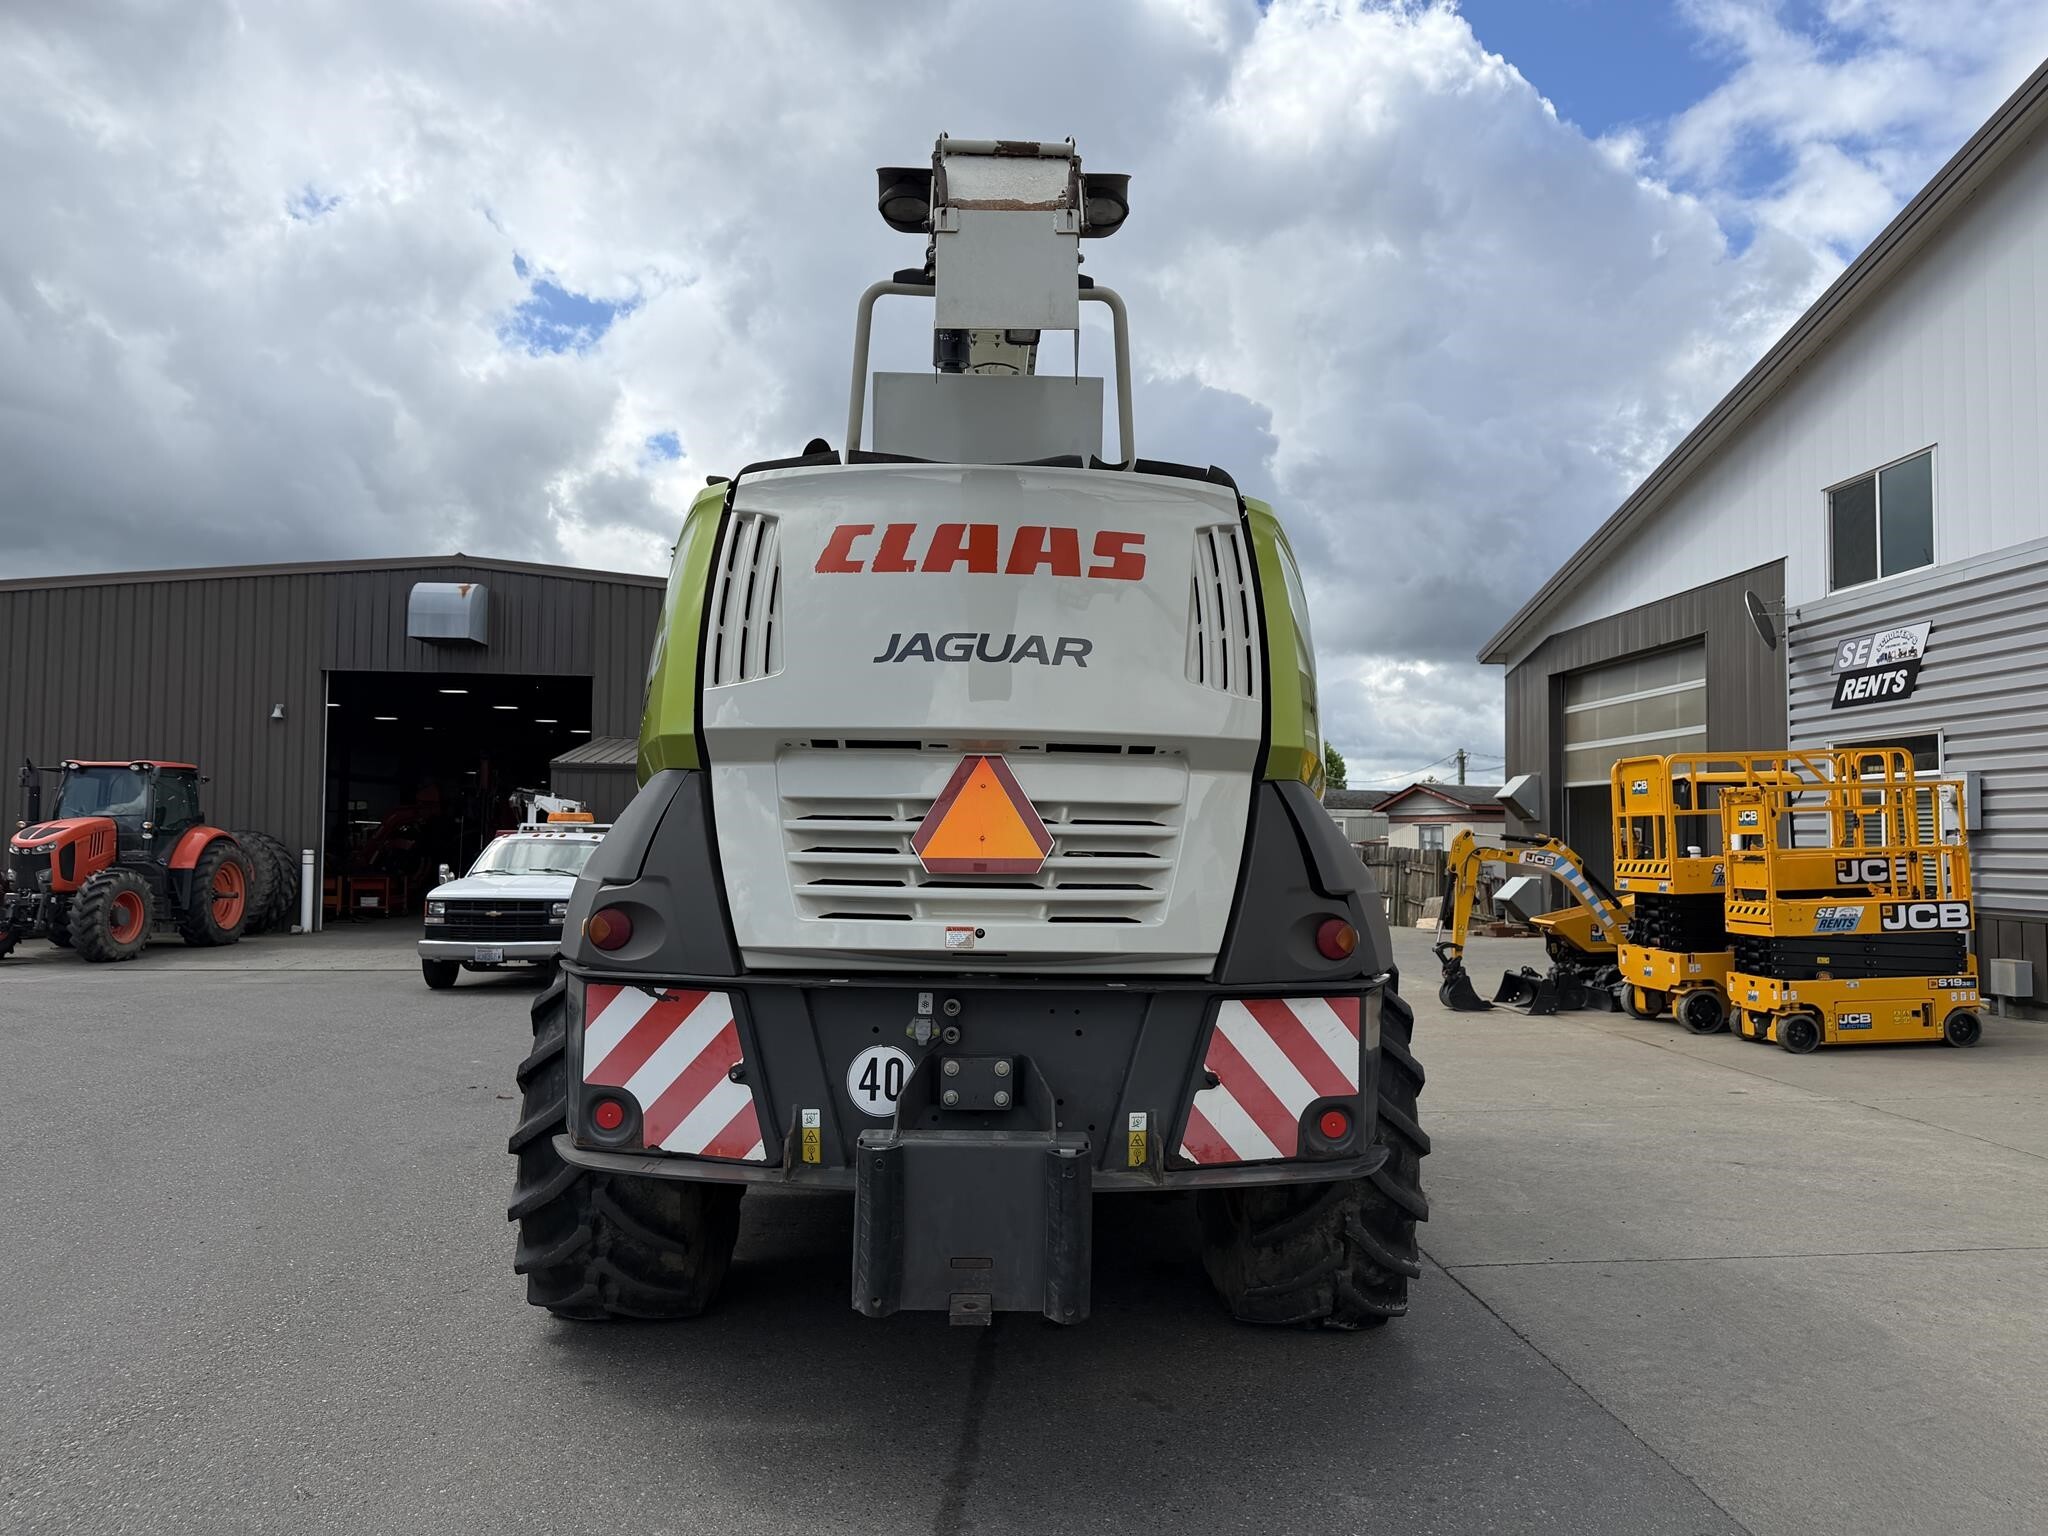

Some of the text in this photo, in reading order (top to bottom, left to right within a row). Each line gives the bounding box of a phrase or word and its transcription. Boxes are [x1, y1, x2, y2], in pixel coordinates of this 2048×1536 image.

[815, 524, 1146, 581] CLAAS
[873, 632, 1093, 668] JAGUAR
[1839, 639, 1872, 668] SE
[1840, 669, 1908, 702] RENTS
[1632, 780, 1648, 790] JCB
[1739, 810, 1758, 821] JCB
[1527, 854, 1555, 866] JCB
[1816, 907, 1835, 918] SE
[1883, 903, 1969, 930] JCB
[1818, 918, 1856, 929] RENTS
[1839, 1013, 1871, 1024] JCB
[858, 1057, 904, 1102] 40
